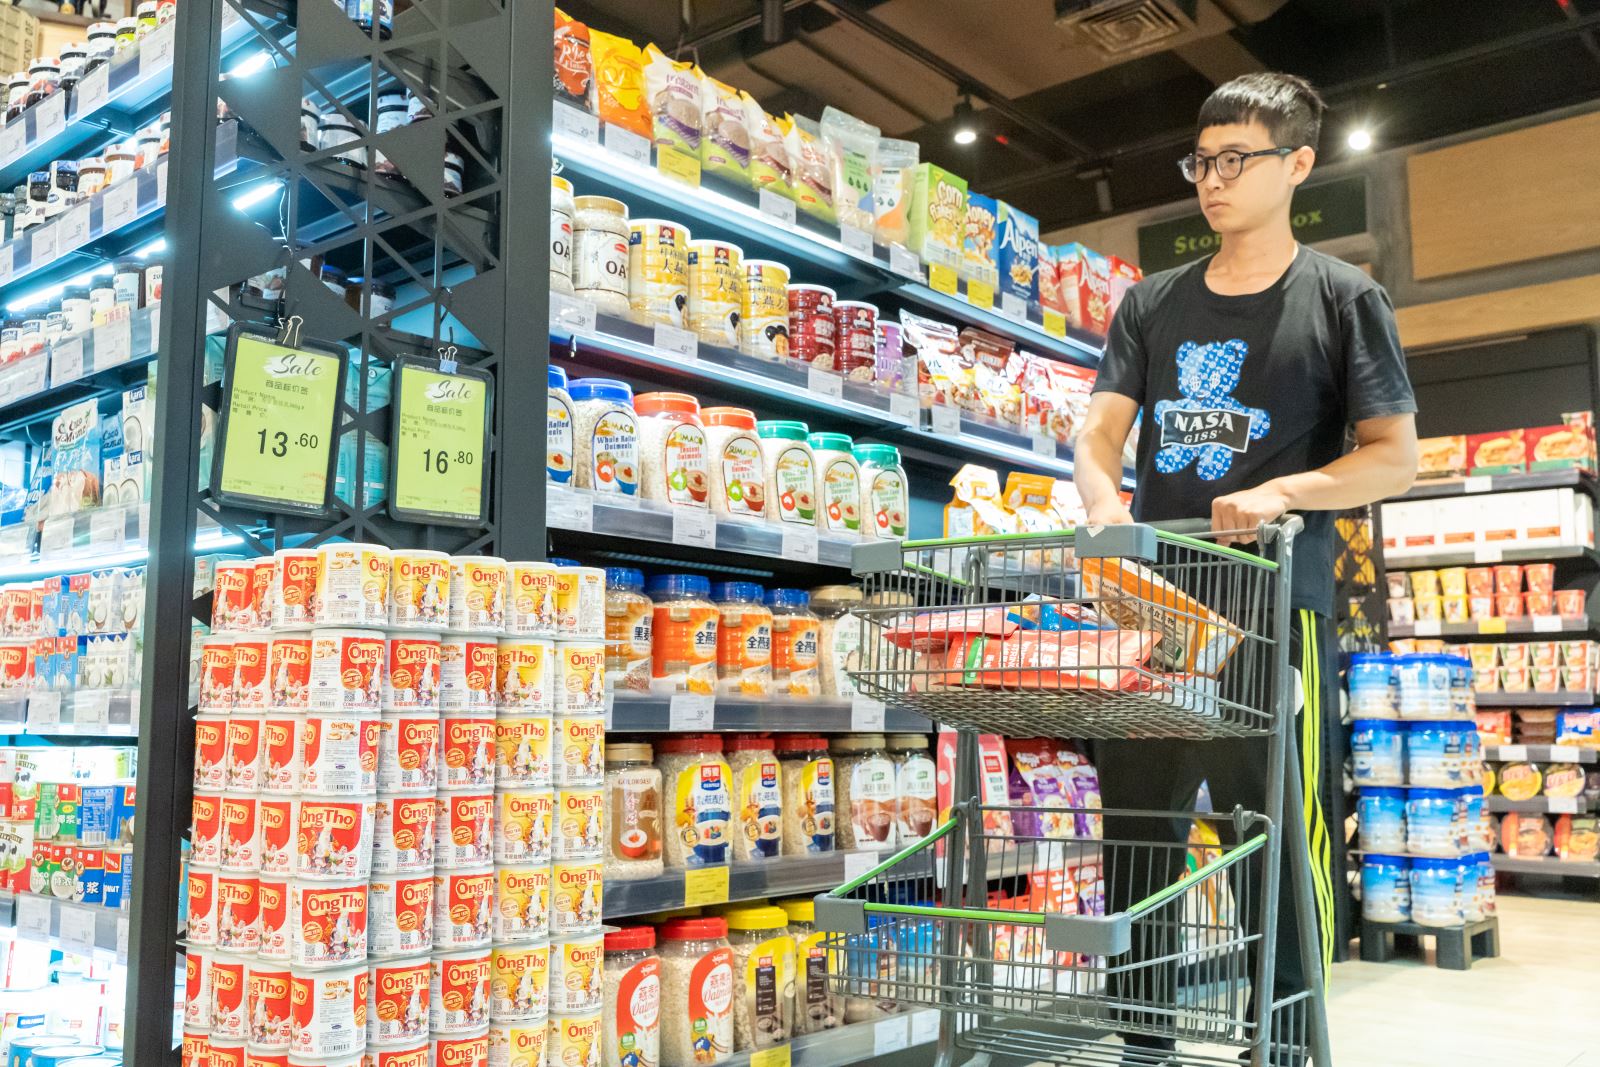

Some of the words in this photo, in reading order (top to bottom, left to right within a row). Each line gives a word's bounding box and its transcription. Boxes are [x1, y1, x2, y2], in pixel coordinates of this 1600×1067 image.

[1292, 210, 1322, 227] ox
[1000, 216, 1038, 258] Alpen
[553, 241, 570, 260] OA
[606, 261, 626, 279] OA
[273, 353, 322, 376] Sale
[434, 379, 472, 400] Sale
[1174, 412, 1234, 432] NASA
